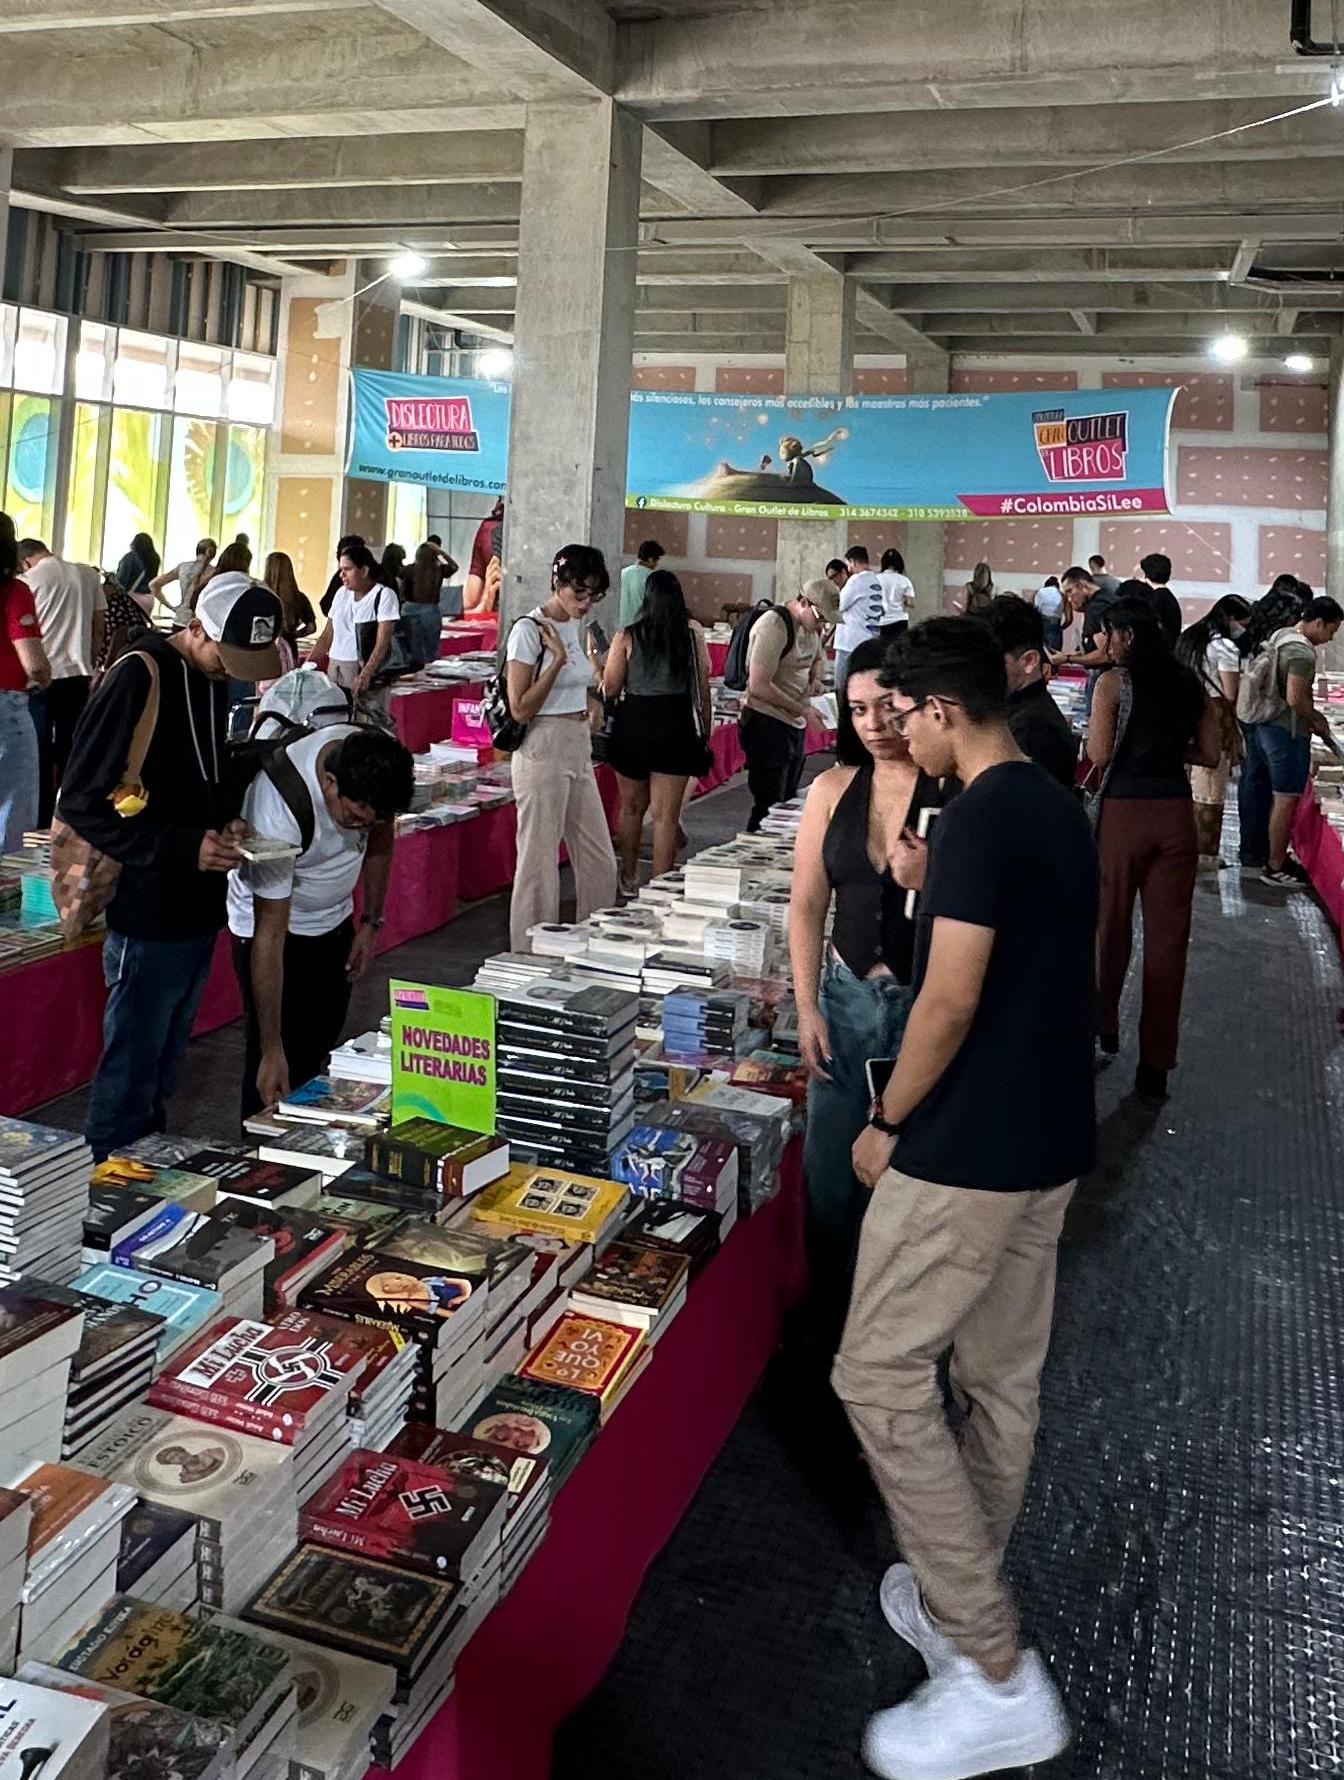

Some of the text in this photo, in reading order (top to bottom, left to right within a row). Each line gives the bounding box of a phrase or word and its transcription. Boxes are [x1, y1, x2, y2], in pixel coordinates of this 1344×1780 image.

[391, 402, 470, 431] DISLECTURA
[714, 396, 763, 409] consejeros
[1068, 415, 1124, 443] OUTLET
[1050, 443, 1123, 479] LIBROS
[759, 504, 786, 516] Outlet
[1000, 494, 1143, 513] #ColombiaSíLee
[402, 1025, 490, 1060] NOVEDADES
[400, 1051, 487, 1086] LITERARIAS
[570, 1340, 600, 1356] YO
[582, 1328, 604, 1343] VI
[189, 1325, 267, 1381] Mi Lucha
[552, 1351, 601, 1369] QUE
[87, 1416, 152, 1469] ESTOICO
[335, 1460, 399, 1521] Mi Lucha
